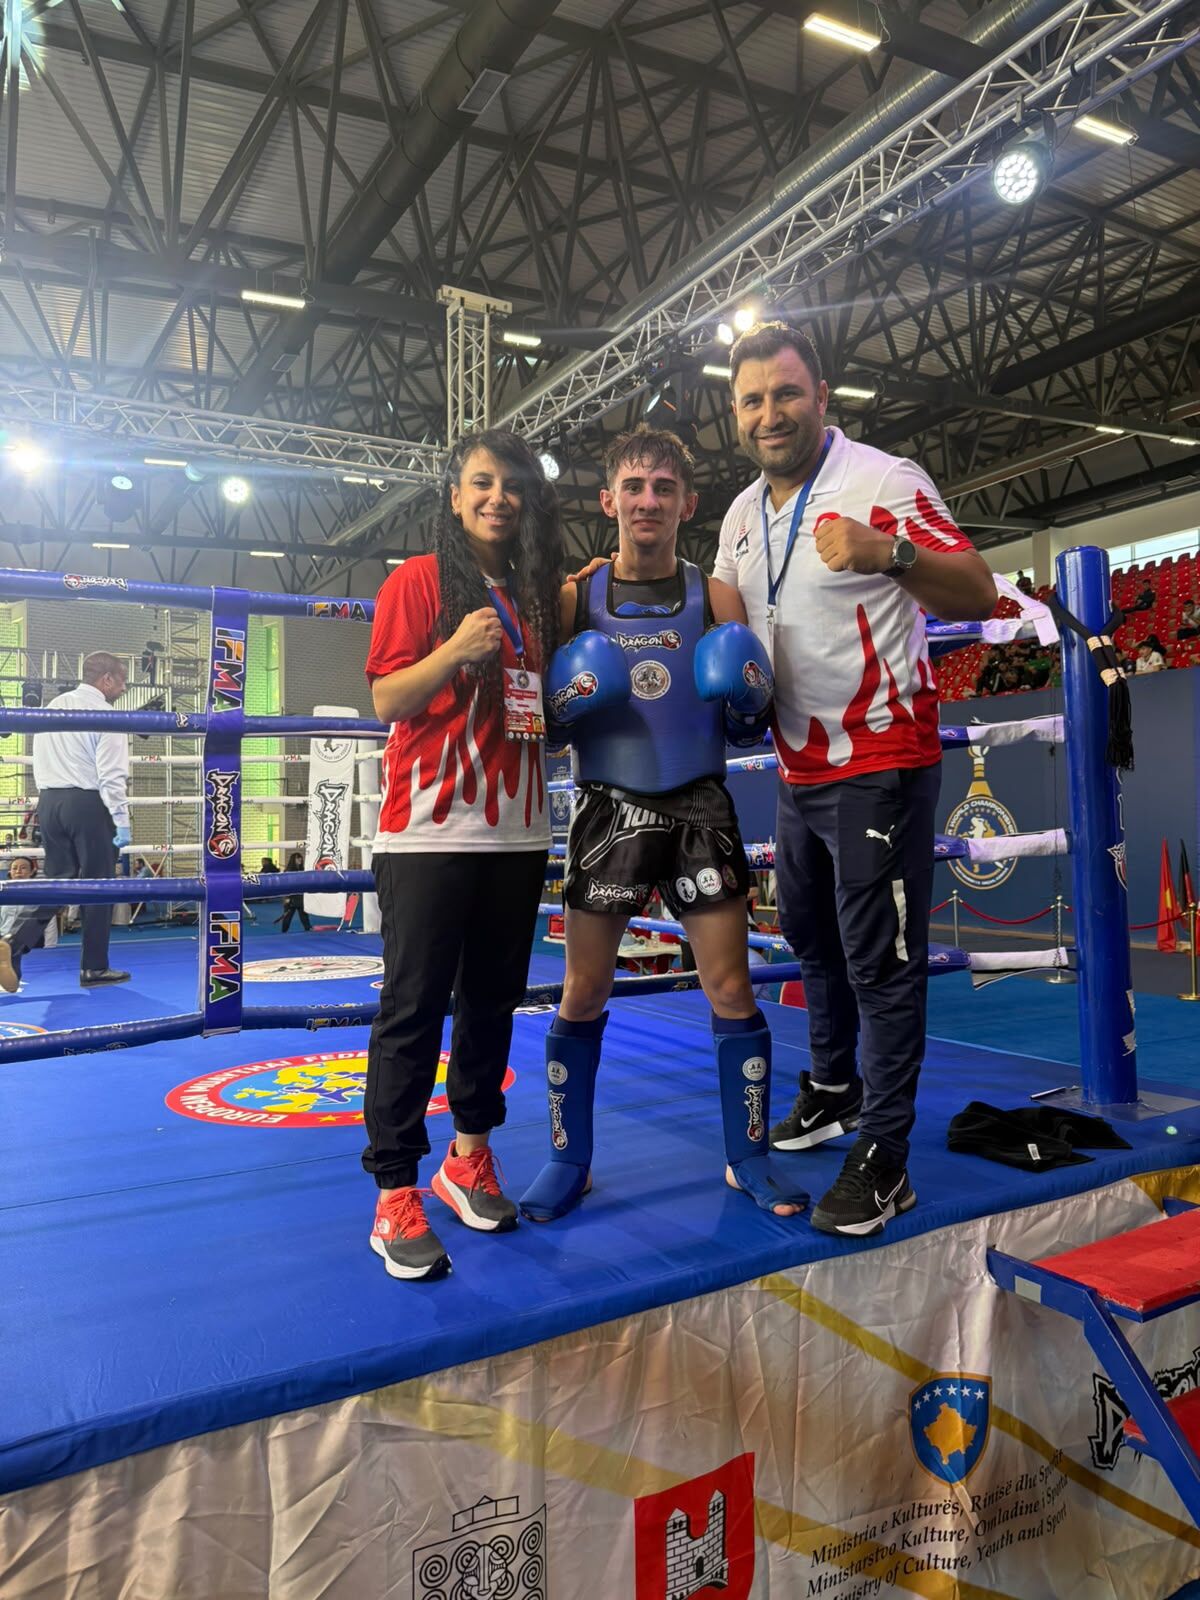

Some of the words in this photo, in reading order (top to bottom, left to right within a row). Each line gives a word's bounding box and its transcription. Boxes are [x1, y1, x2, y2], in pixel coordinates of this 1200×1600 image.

[307, 602, 367, 621] IFMA
[616, 631, 663, 653] DRAGON
[212, 627, 245, 713] IFMA
[206, 768, 240, 833] DRAGON
[314, 779, 349, 858] DRAGON
[585, 878, 639, 904] DRAGON
[209, 911, 240, 1003] IFMA
[179, 1094, 289, 1124] EUROPEAN
[183, 1060, 294, 1093] MUAYTHAI
[806, 1542, 897, 1598] Ministarstvo
[901, 1526, 970, 1550] Kulture,
[974, 1500, 1040, 1537] Omladine
[810, 1524, 877, 1568] Ministria
[880, 1519, 889, 1534] e
[891, 1499, 964, 1529] Kulturës,
[1015, 1474, 1037, 1493] dhe
[885, 1559, 900, 1588] of
[903, 1552, 972, 1576] Culture,
[976, 1529, 1013, 1562] Youth
[1017, 1520, 1044, 1542] and
[1046, 1503, 1067, 1535] Sport
